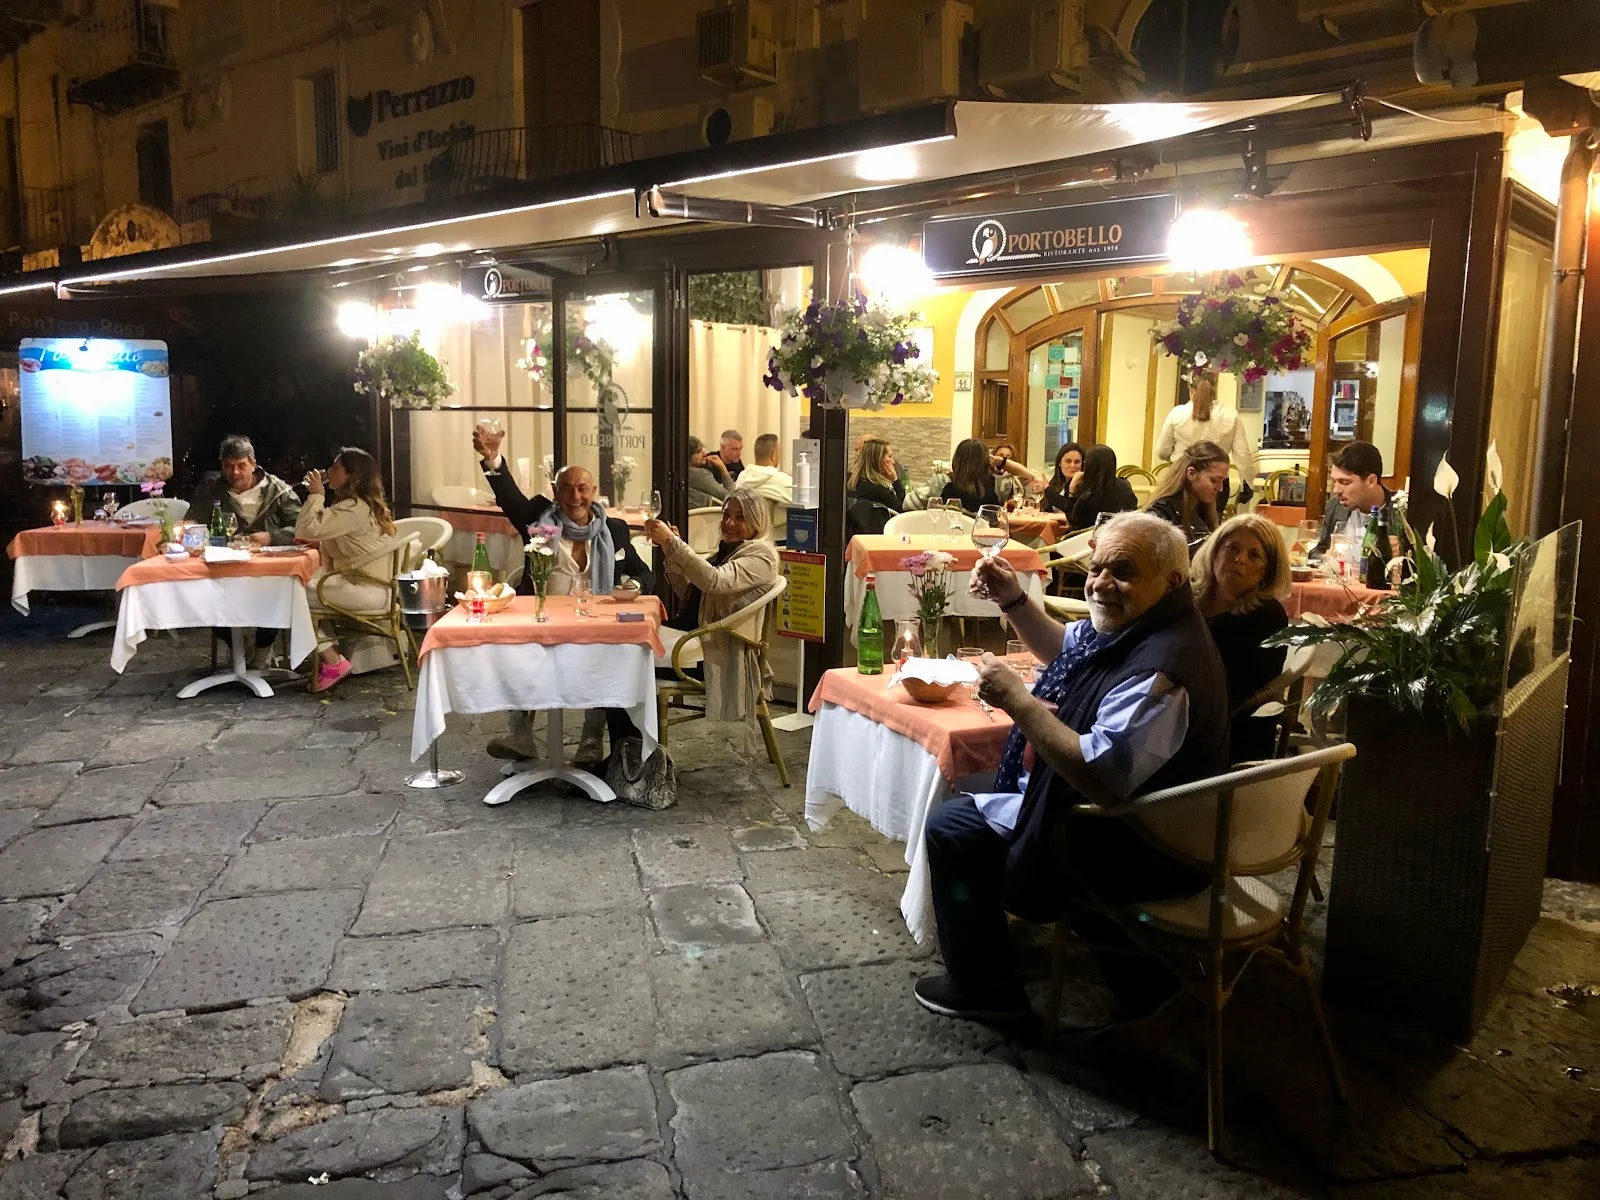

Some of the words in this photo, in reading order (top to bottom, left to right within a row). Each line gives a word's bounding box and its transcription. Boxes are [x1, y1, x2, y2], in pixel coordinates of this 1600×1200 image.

[377, 76, 475, 122] Perrazzo
[375, 135, 409, 161] Vini
[413, 119, 476, 154] d'Ischia
[394, 164, 418, 190] dal
[1007, 223, 1123, 253] PORTOBELLO
[1043, 248, 1085, 258] RISTORANTE
